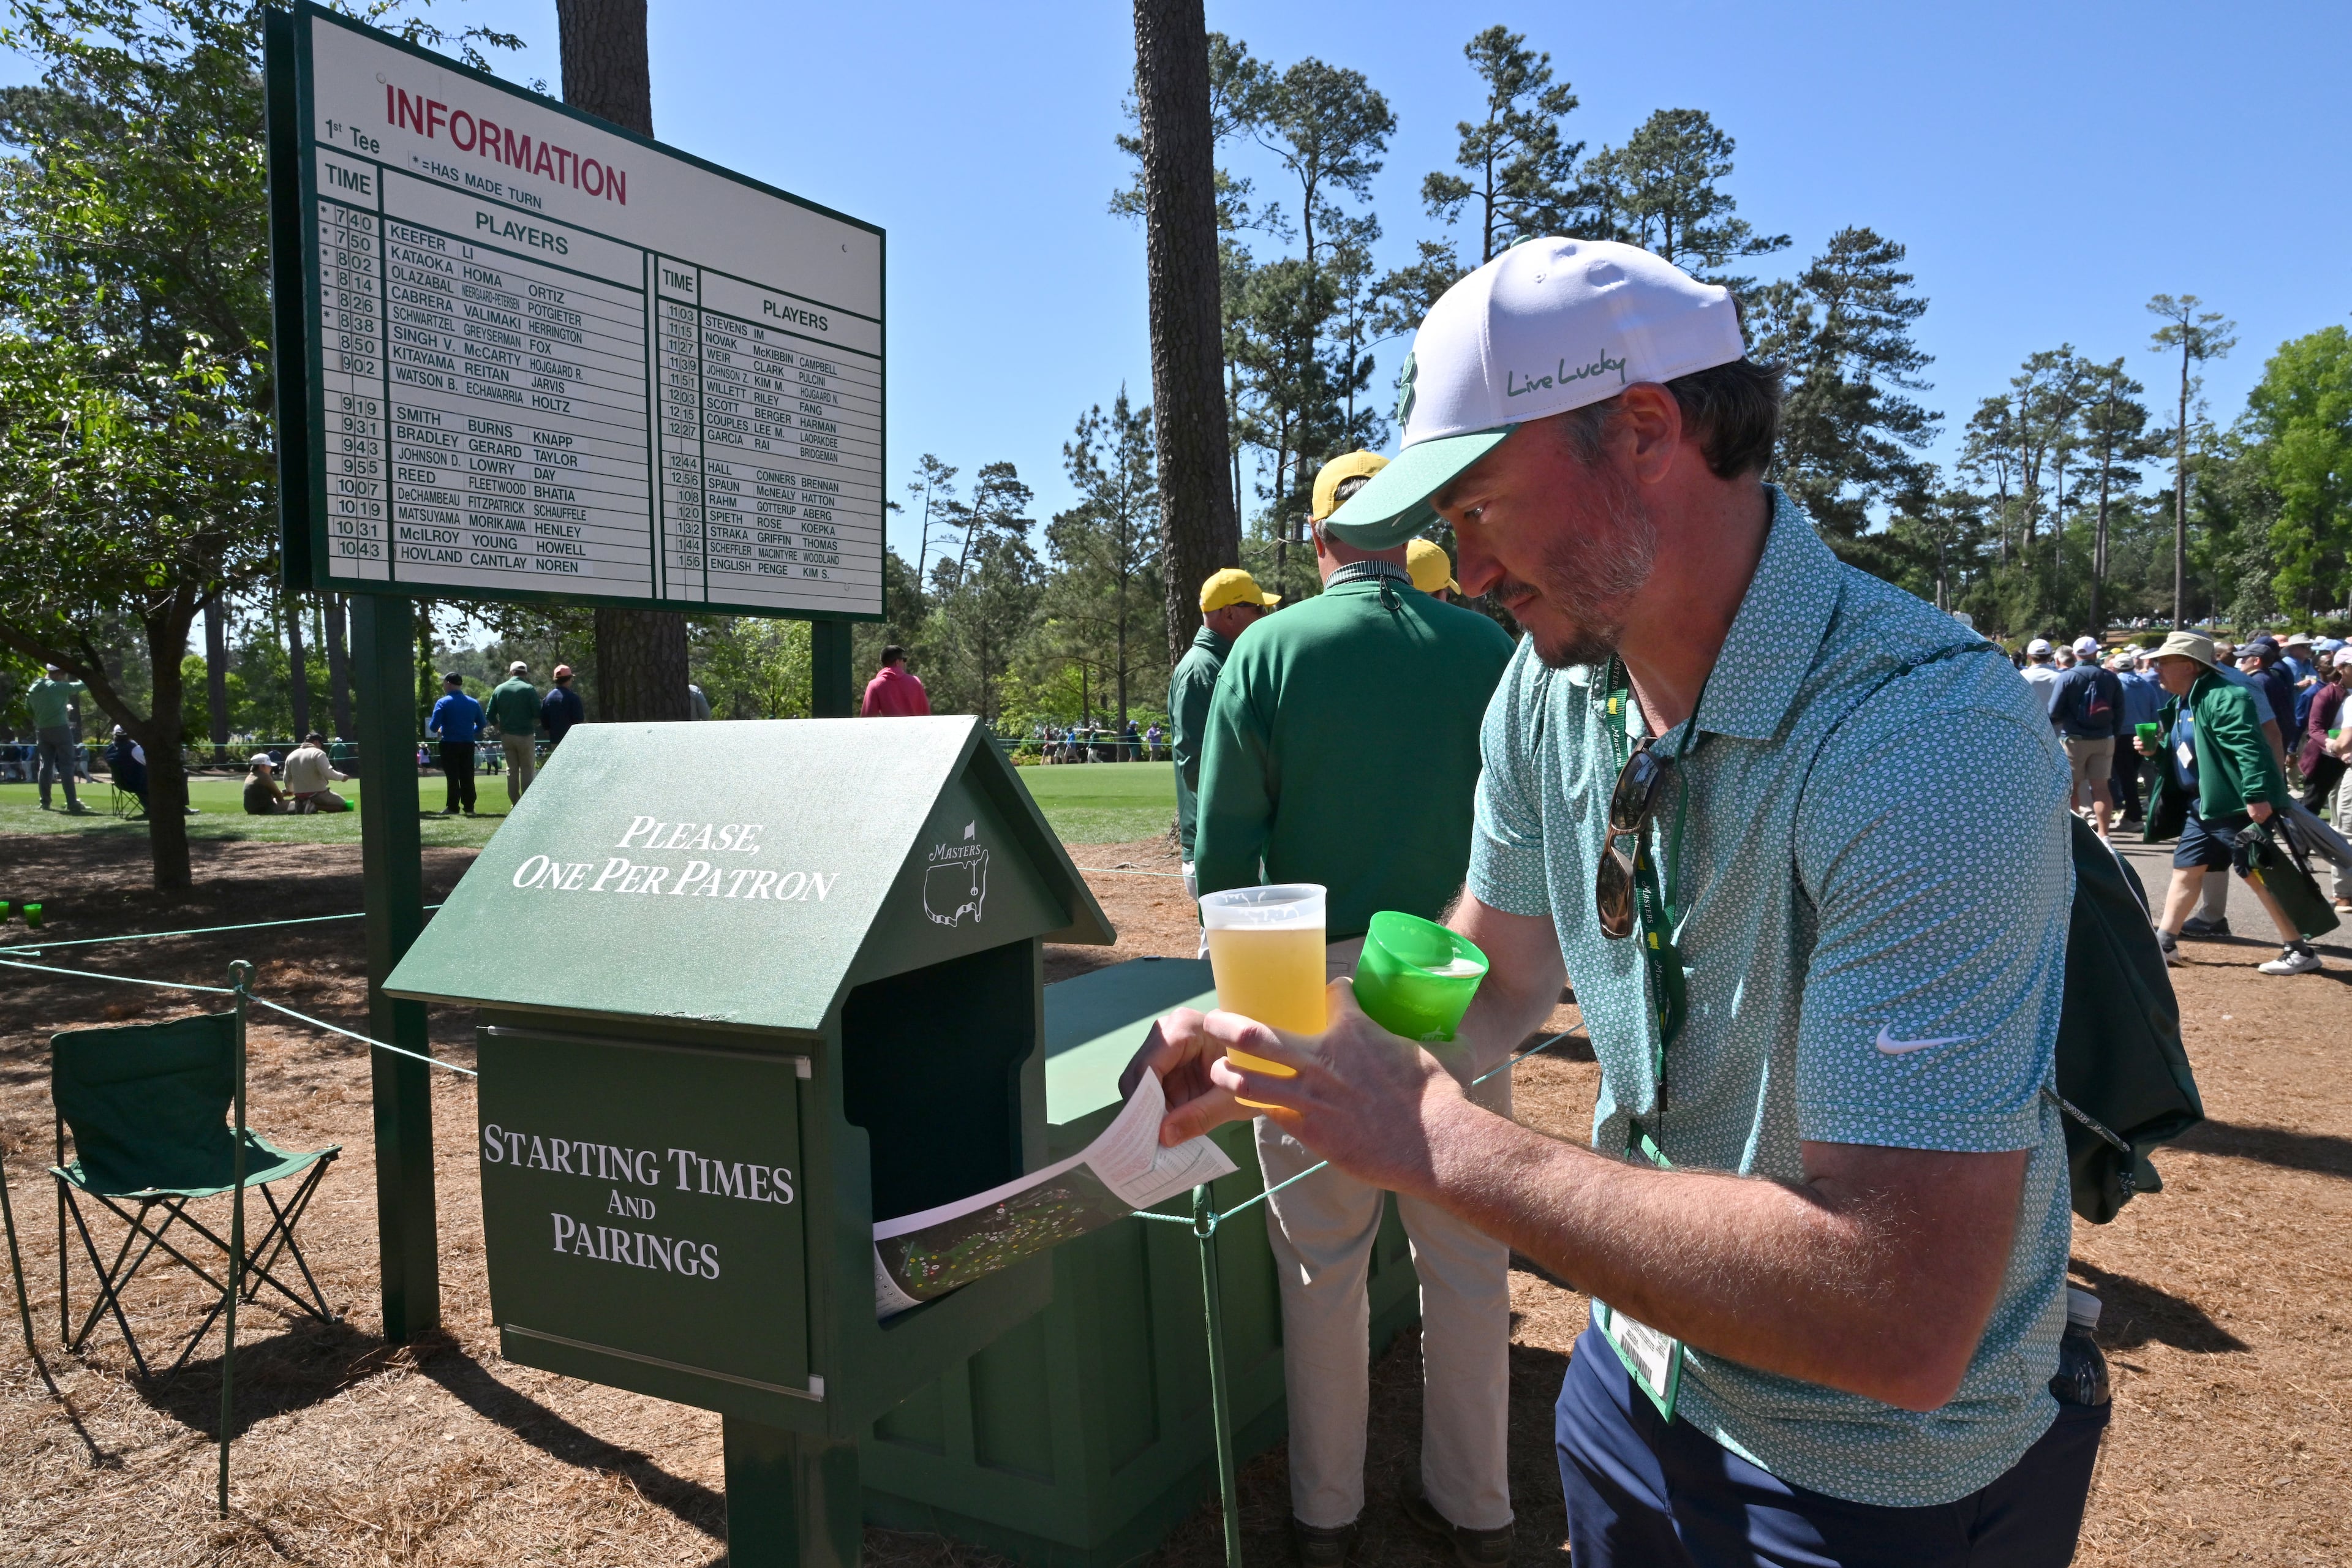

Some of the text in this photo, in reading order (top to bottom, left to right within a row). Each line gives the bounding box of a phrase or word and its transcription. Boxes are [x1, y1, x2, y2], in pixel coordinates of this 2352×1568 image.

[325, 119, 380, 154] 1st Tee
[386, 85, 627, 206] INFORMATION
[325, 163, 568, 255] TIME PLAYERS
[466, 173, 502, 196] MADE
[508, 187, 542, 209] TURN
[391, 224, 446, 252] KEEFER
[462, 245, 473, 260] LI
[391, 246, 453, 274] KATAOKA
[463, 266, 502, 288] HOMA
[529, 284, 565, 304] ORTIZ
[391, 265, 454, 294] OLAZABAL
[528, 301, 581, 326] POTGIETER
[662, 268, 828, 331] TIME PLAYERS
[391, 285, 453, 312] CABRERA
[464, 304, 521, 330] VALIMAKI
[529, 320, 582, 344] HERRINGTON
[393, 306, 455, 332] SCHWARTZEL
[464, 323, 521, 348] GREYSERMAN
[530, 339, 551, 355] FOX
[706, 315, 747, 336] STEVENS
[754, 328, 764, 341] IM
[393, 345, 455, 371] KITAYAMA
[465, 362, 509, 382] REITAN
[531, 376, 565, 394] JARVIS
[394, 326, 437, 348] SINGH
[464, 342, 521, 366] McCARTY
[530, 358, 573, 378] HOJGAARD
[706, 332, 737, 350] NOVAK
[753, 345, 793, 364] McKIBBIN
[799, 357, 837, 375] CAMPBELL
[707, 348, 730, 364] WEIR
[753, 360, 784, 377] CLARK
[799, 371, 826, 387] PULCINI
[396, 366, 443, 388] WATSON
[467, 382, 524, 404] ECHAVARRIA
[532, 394, 570, 413] HOLTZ
[706, 364, 740, 382] JOHNSON
[755, 375, 771, 389] KIM
[801, 387, 831, 402] HOJGAARD
[1507, 349, 1626, 398] Live Lucky
[706, 380, 747, 399] WILLETT
[754, 392, 779, 406] RILEY
[799, 402, 822, 415] FANG
[707, 397, 739, 413] SCOTT
[755, 407, 791, 424] BERGER
[800, 417, 836, 434] HARMAN
[397, 407, 440, 426] SMITH
[468, 419, 513, 438] BURNS
[533, 431, 573, 448] KNAPP
[707, 413, 748, 431] COUPLES
[755, 423, 771, 435] LEE
[800, 432, 838, 448] LAOPAKDEE
[707, 429, 744, 445] GARCIA
[755, 438, 769, 451] RAI
[800, 447, 838, 462] BRIDGEMAN
[397, 425, 459, 448] BRADLEY
[469, 439, 522, 458] GERARD
[533, 449, 578, 467] TAYLOR
[398, 447, 447, 466] JOHNSON
[470, 458, 515, 475] LOWRY
[534, 467, 556, 481] DAY
[398, 467, 436, 484] REED
[469, 476, 526, 495] FLEETWOOD
[534, 485, 575, 502] BHATIA
[708, 461, 732, 475] HALL
[756, 470, 796, 486] CONNERS
[801, 477, 839, 492] BRENNAN
[709, 478, 739, 492] SPAUN
[756, 485, 796, 500] McNEALY
[802, 492, 834, 507] HATTON
[398, 487, 460, 507] DeCHAMBEAU
[469, 496, 525, 514] FITZPATRICK
[534, 503, 587, 521] SCHAUFFELE
[399, 506, 461, 525] MATSUYAMA
[469, 514, 526, 532] MORIKAWA
[535, 522, 581, 538] HENLEY
[709, 494, 737, 508] RAHM
[757, 501, 796, 515] GOTTERUP
[803, 508, 832, 521] ABERG
[710, 510, 742, 524] SPIETH
[757, 517, 782, 529] ROSE
[801, 522, 835, 536] KOEPKA
[710, 526, 748, 540] STRAKA
[757, 532, 791, 545] GRIFFIN
[802, 538, 837, 551] THOMAS
[400, 527, 460, 544] McILROY
[472, 534, 518, 550] YOUNG
[537, 540, 586, 556] HOWELL
[401, 546, 462, 563] HOVLAND
[470, 552, 527, 569] CANTLAY
[536, 559, 578, 573] NOREN
[710, 541, 752, 556] SCHEFFLER
[758, 548, 797, 561] MACINTYRE
[803, 552, 839, 565] WOODLAND
[710, 558, 751, 572] ENGLISH
[758, 562, 788, 575] PENGE
[803, 567, 818, 578] KIM
[615, 815, 763, 855] PLEASE,
[513, 855, 840, 902] ONE PER PATRON
[484, 1123, 794, 1205] STARTING TIMES
[606, 1189, 656, 1221] AND
[551, 1213, 720, 1280] PAIRINGS
